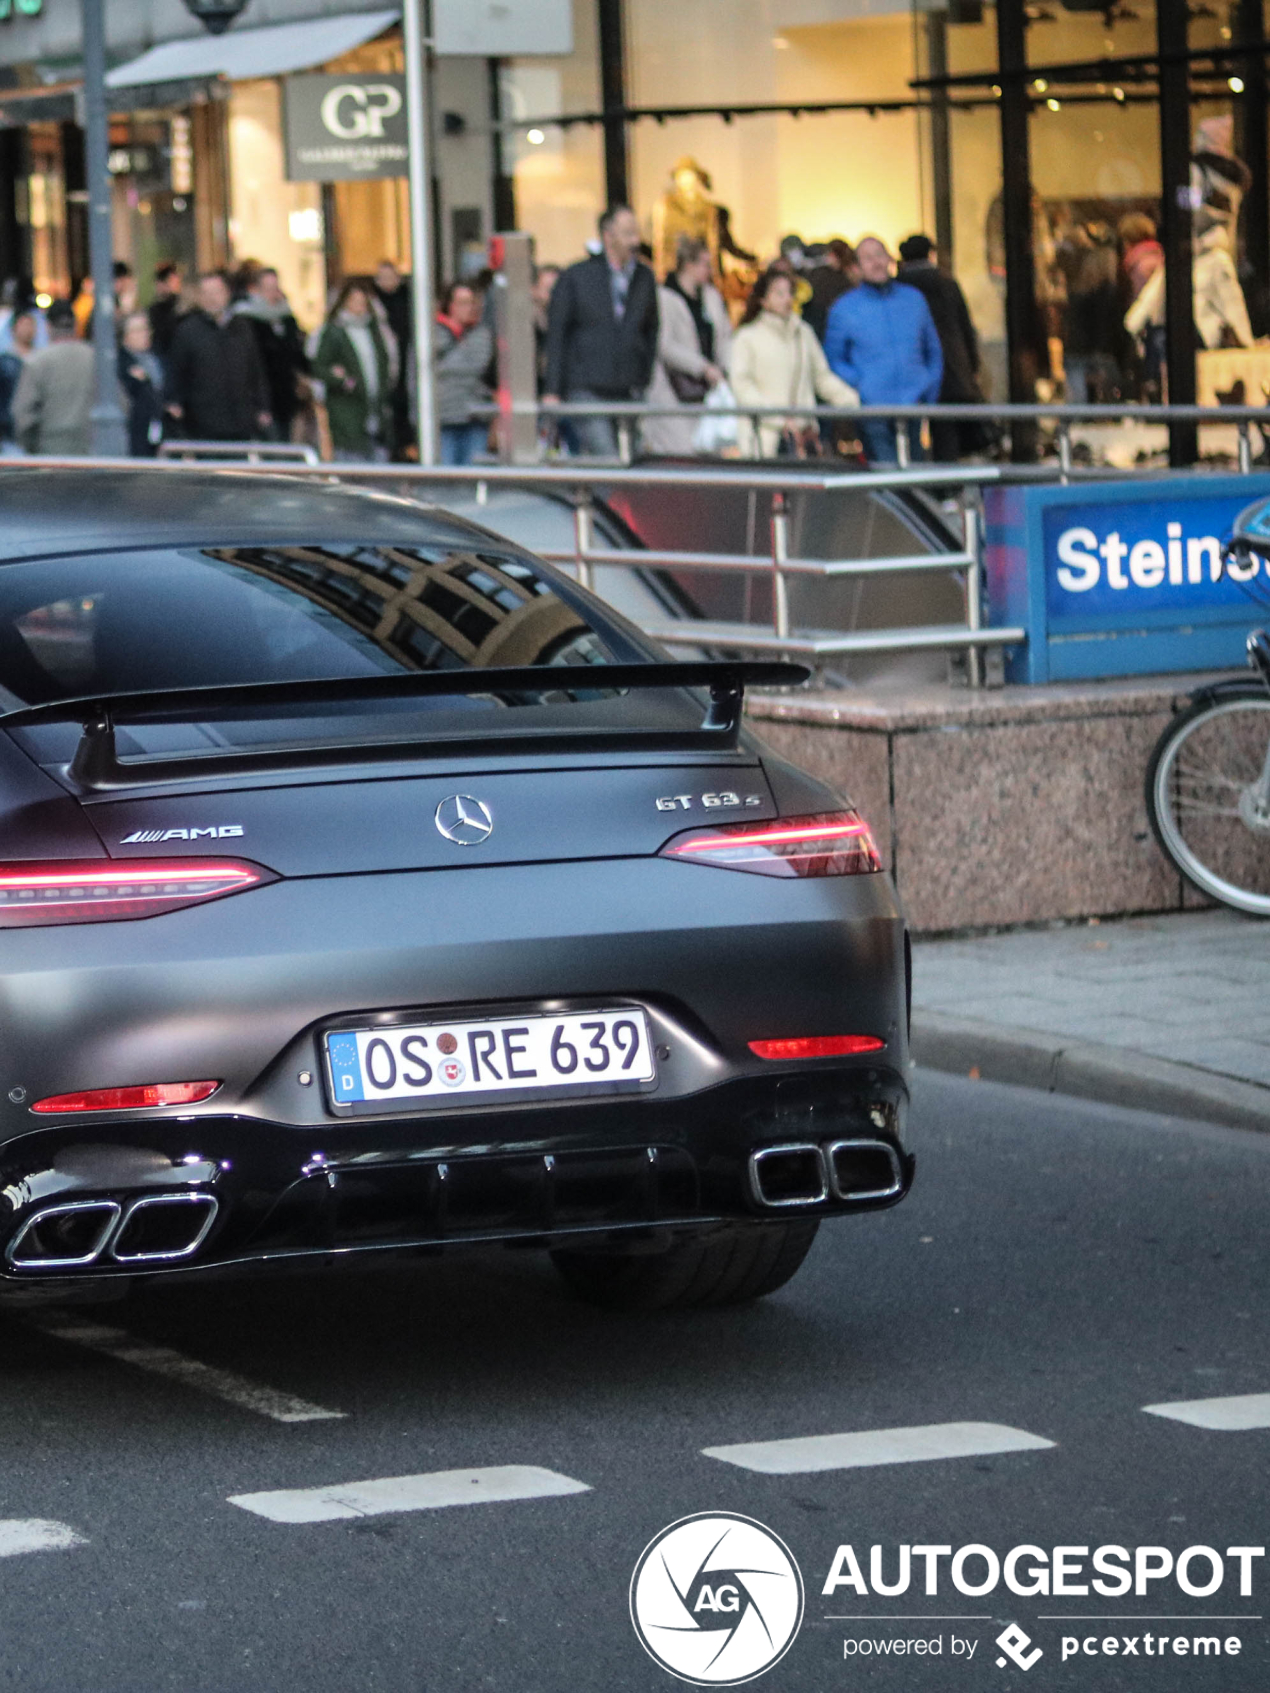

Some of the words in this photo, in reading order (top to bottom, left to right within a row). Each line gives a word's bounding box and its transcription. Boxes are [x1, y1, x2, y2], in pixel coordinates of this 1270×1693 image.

[320, 83, 402, 139] GP
[655, 795, 693, 812] GT
[701, 791, 741, 808] 63
[160, 825, 245, 842] AMG
[341, 1073, 355, 1092] D
[364, 1034, 434, 1092] OS
[466, 1027, 538, 1082] RE
[549, 1020, 641, 1076] 639
